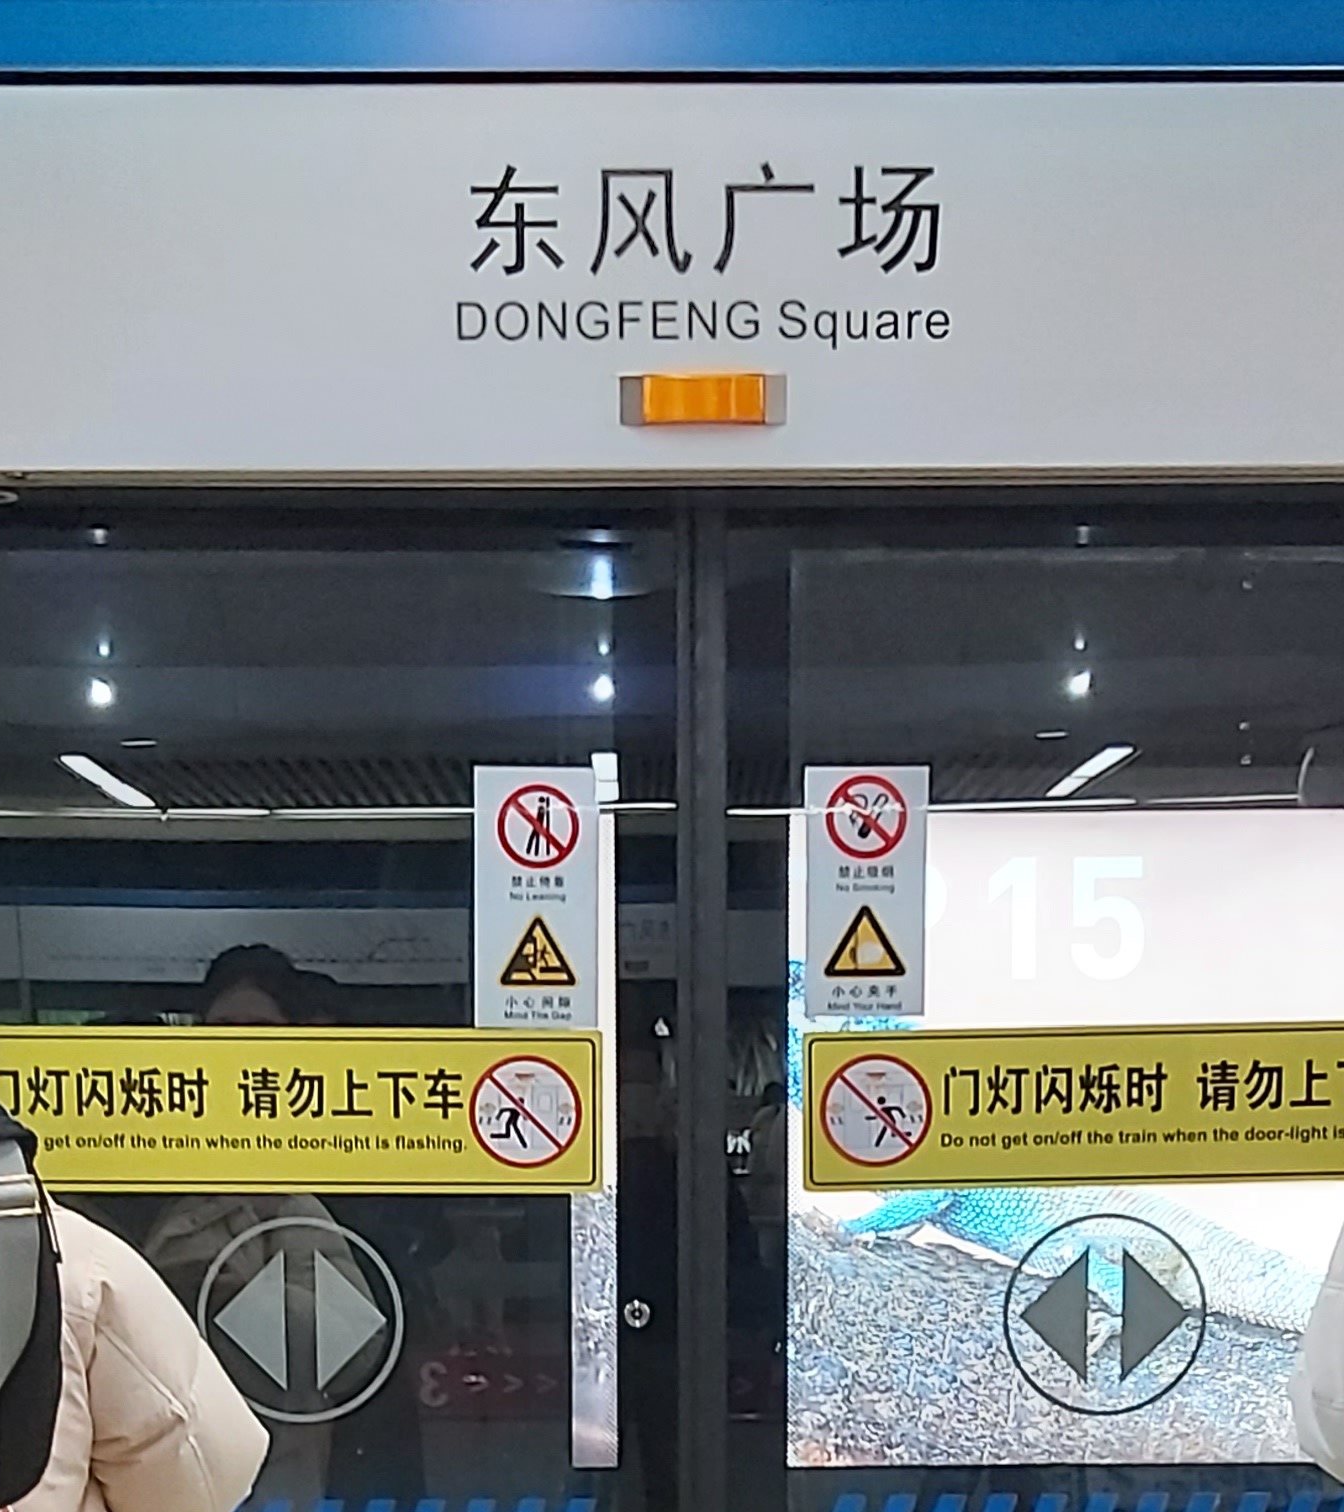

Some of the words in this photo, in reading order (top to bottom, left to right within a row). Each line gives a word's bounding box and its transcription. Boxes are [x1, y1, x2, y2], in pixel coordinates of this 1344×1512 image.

[470, 162, 941, 275] 东风广场
[456, 300, 760, 341] DONGFENG
[778, 300, 951, 350] Square
[238, 1067, 464, 1120] 请勿上下车
[943, 1062, 1169, 1116] 门灯闪烁时
[44, 1134, 71, 1152] get
[76, 1133, 125, 1149] on/off
[131, 1134, 157, 1149] the
[162, 1134, 201, 1149] train
[205, 1134, 251, 1149] when
[256, 1134, 283, 1149] the
[288, 1134, 370, 1152] door-light
[375, 1135, 390, 1149] is
[395, 1134, 467, 1153] flashing.
[940, 1132, 964, 1148] Do
[969, 1132, 996, 1147] not
[1001, 1132, 1028, 1150] get
[1033, 1130, 1082, 1146] on/off
[1087, 1130, 1113, 1145] the
[1119, 1129, 1158, 1144] train
[1162, 1128, 1207, 1143] when
[1212, 1127, 1239, 1142] the
[1244, 1126, 1328, 1144] door-light
